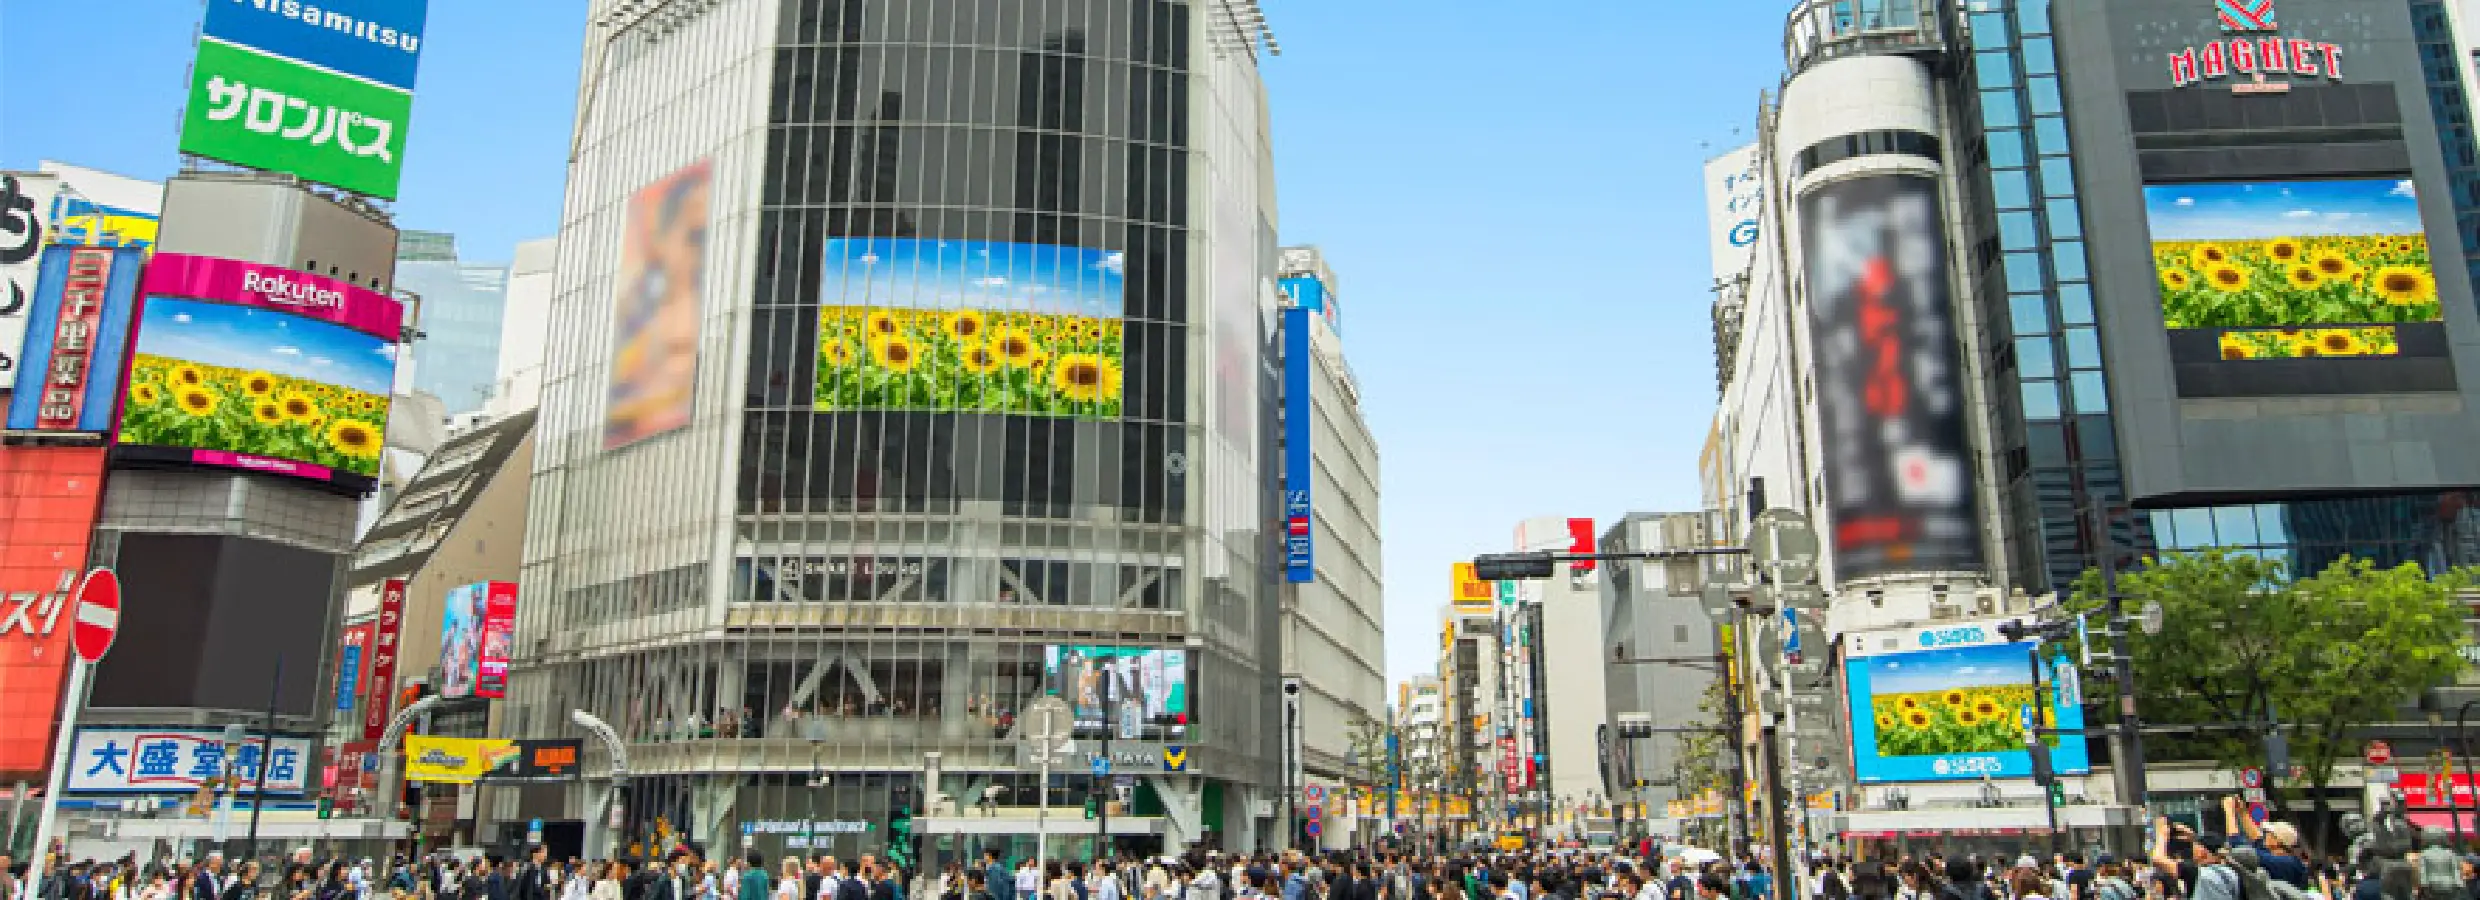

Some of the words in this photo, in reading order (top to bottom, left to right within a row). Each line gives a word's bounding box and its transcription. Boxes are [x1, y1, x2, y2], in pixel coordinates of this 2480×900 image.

[234, 0, 418, 52] isamitsu
[2168, 36, 2342, 88] MAGNET
[206, 75, 392, 163] サロンパス
[242, 269, 345, 310] Rakuten
[375, 588, 402, 667] カラオケ
